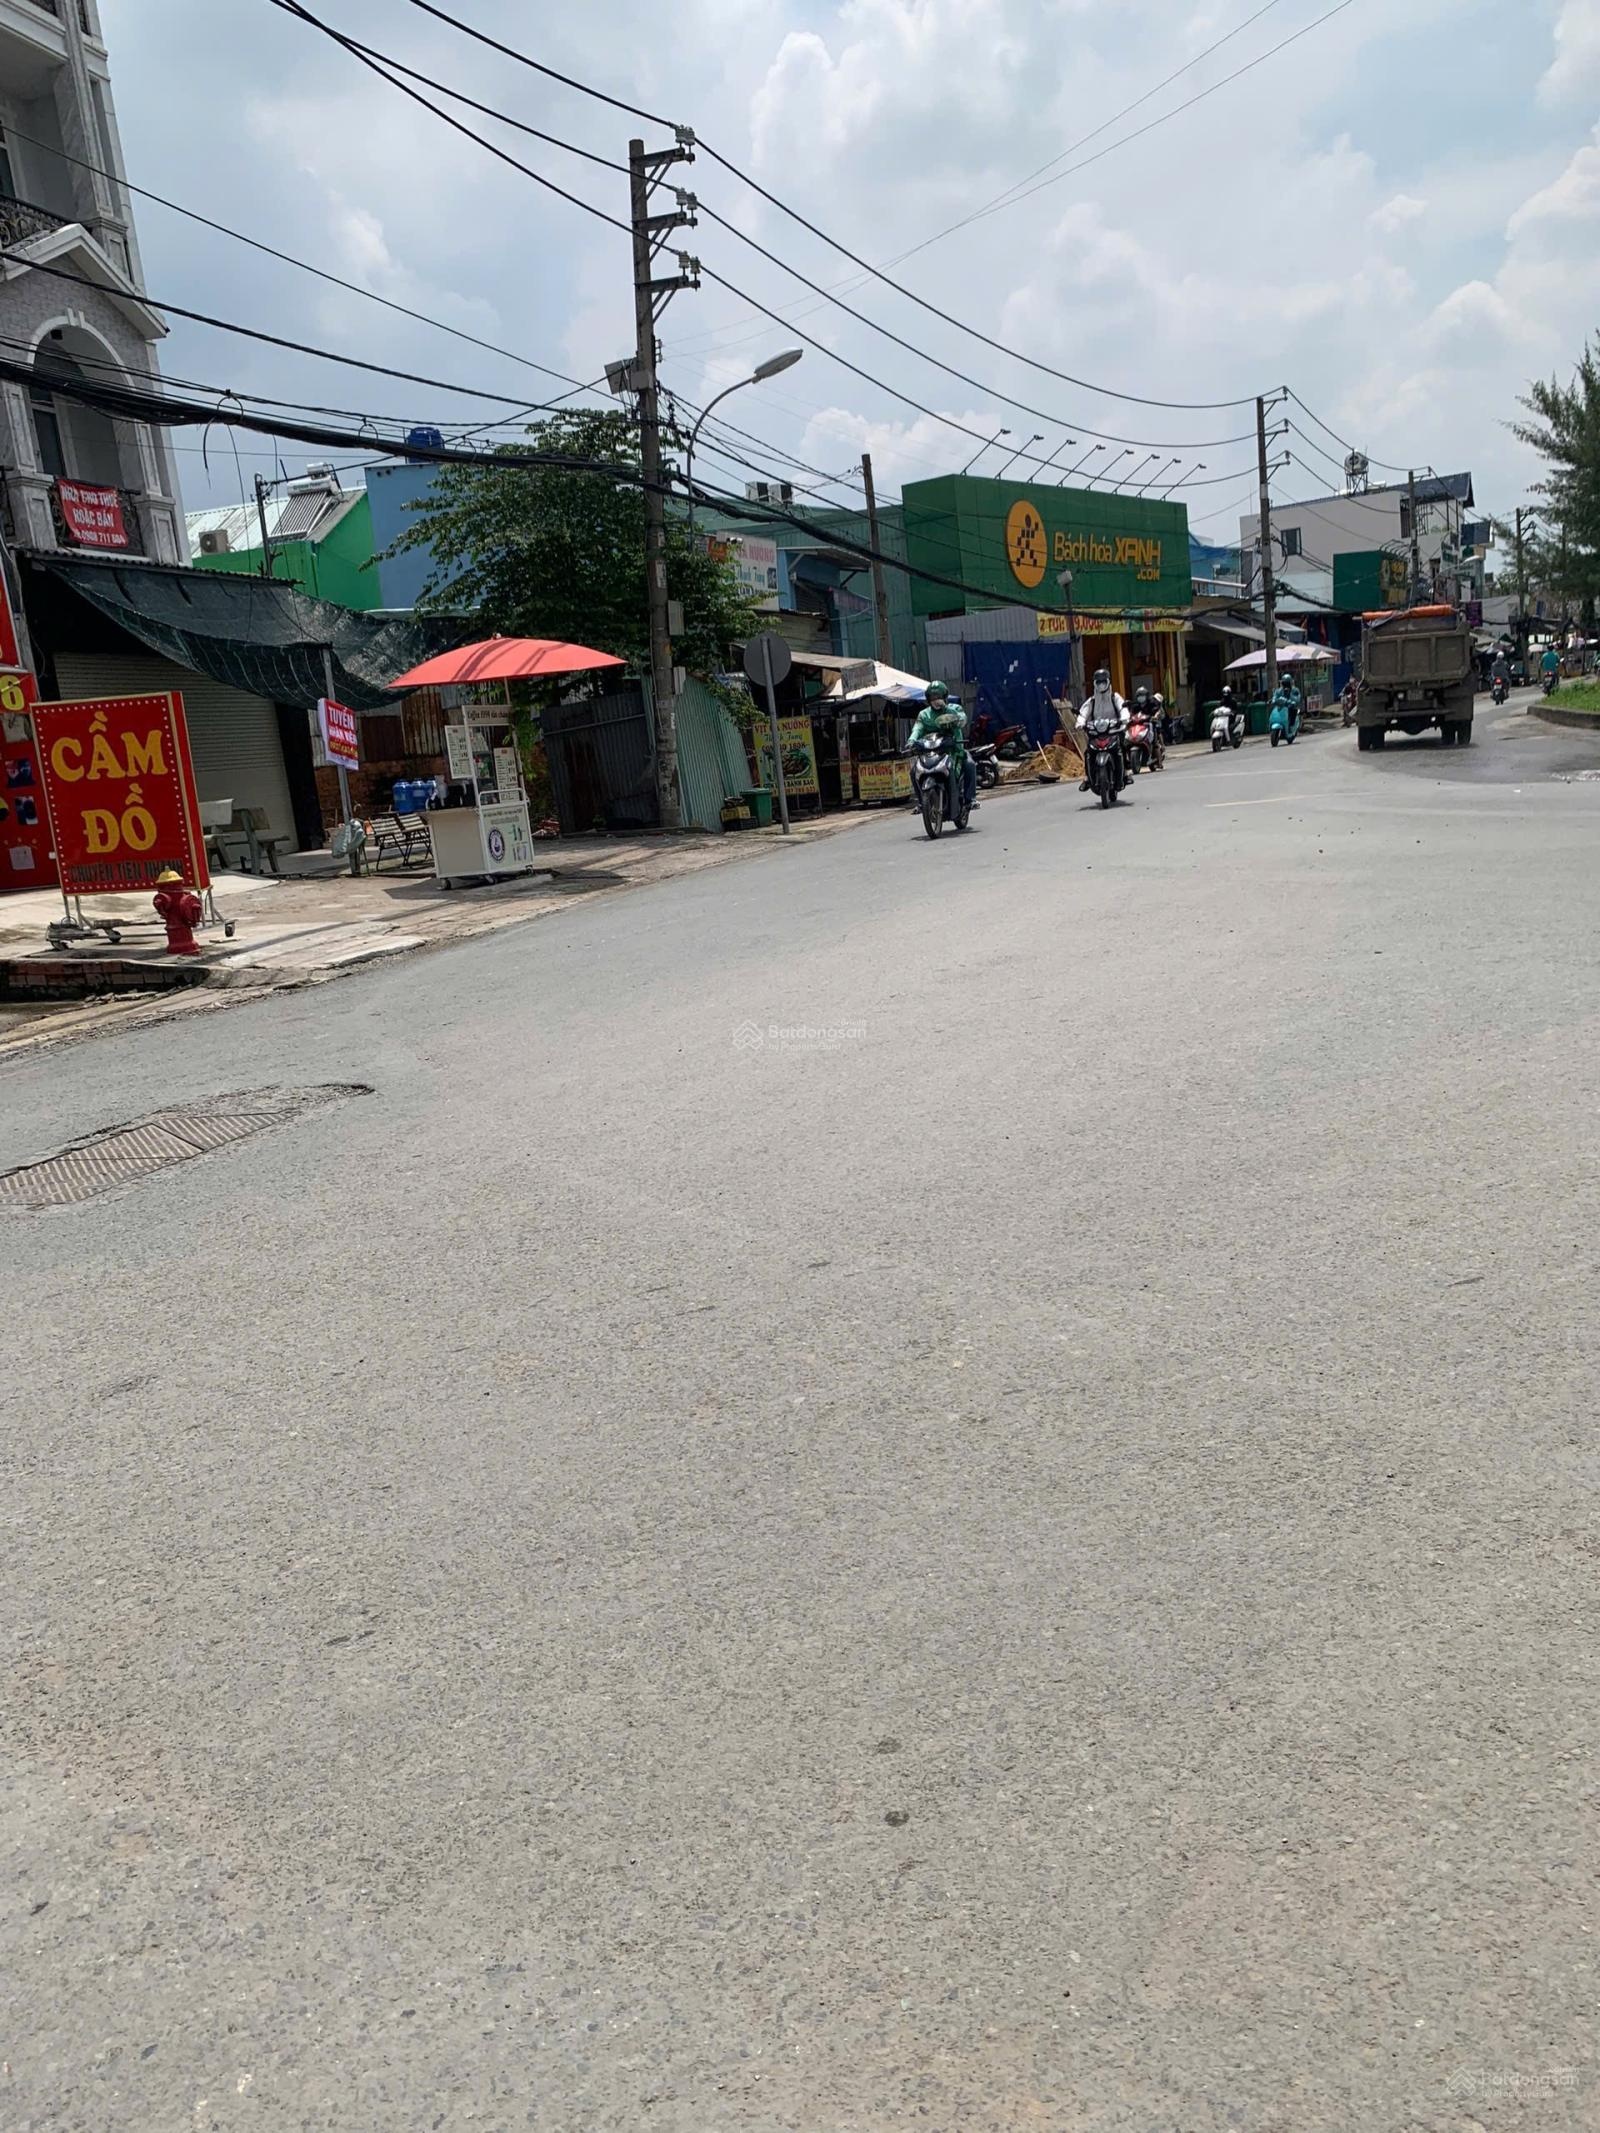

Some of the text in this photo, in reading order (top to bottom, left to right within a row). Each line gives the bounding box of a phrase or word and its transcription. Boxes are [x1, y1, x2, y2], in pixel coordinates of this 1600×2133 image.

[97, 509, 114, 527] BÁN
[1055, 532, 1161, 566] Bách hóa XANH
[1137, 568, 1160, 581] .COM
[1040, 618, 1046, 631] 2
[51, 711, 168, 782] CẦM
[80, 783, 157, 853] ĐỒ
